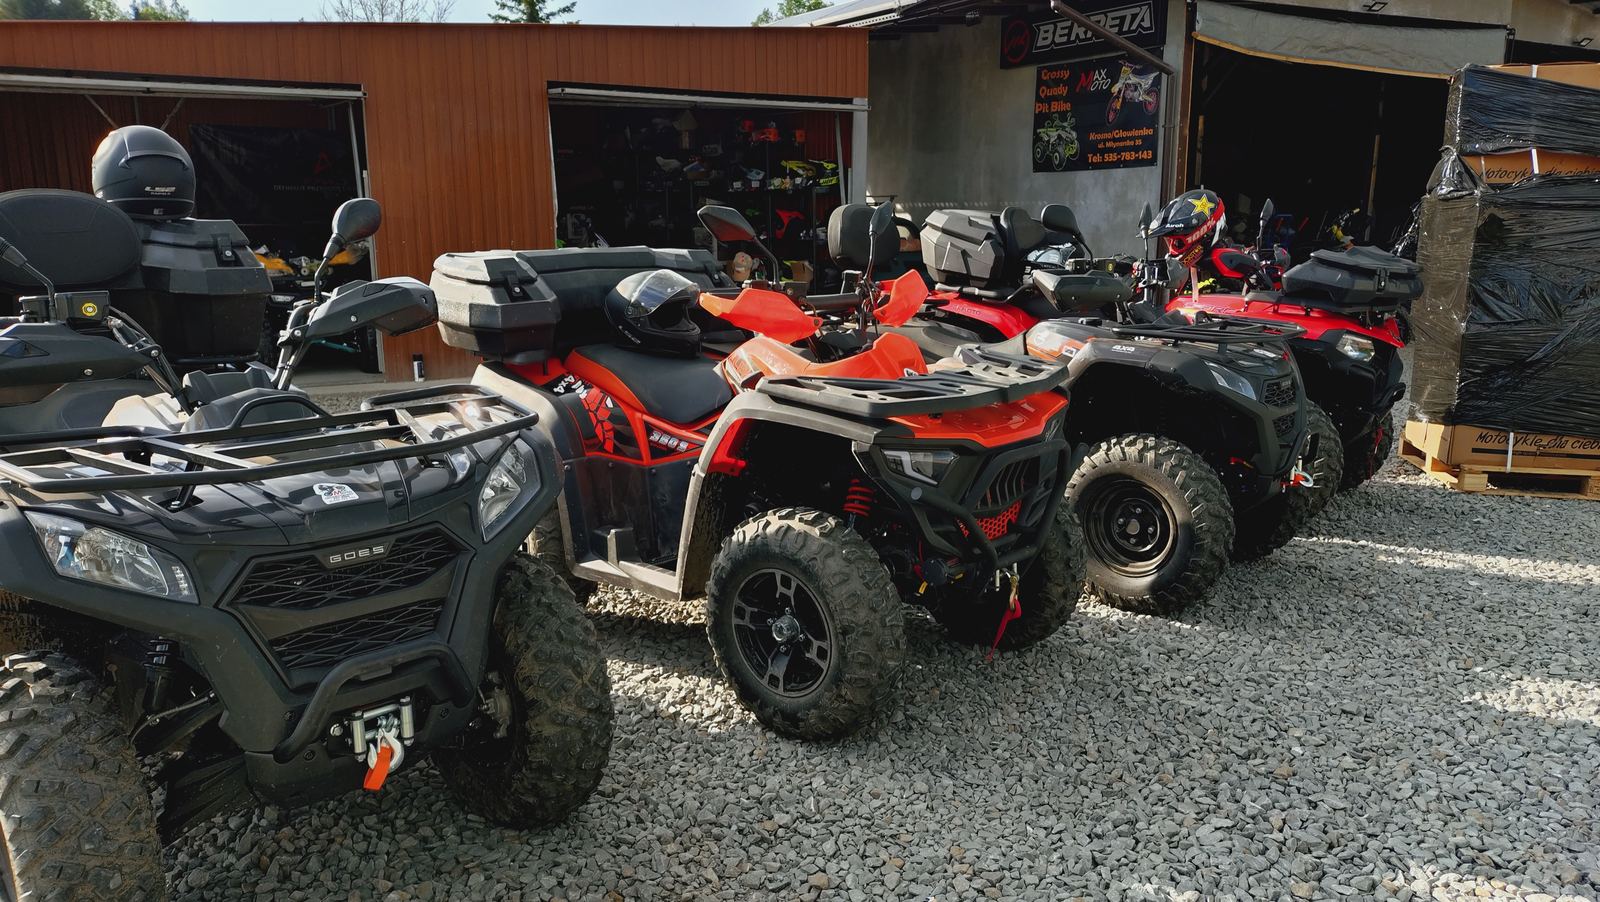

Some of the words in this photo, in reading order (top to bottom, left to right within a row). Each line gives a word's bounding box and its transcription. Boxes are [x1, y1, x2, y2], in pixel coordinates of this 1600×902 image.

[1041, 69, 1070, 80] Crossy
[1040, 84, 1068, 98] Quady
[1035, 101, 1049, 113] Pit
[1051, 100, 1071, 112] Bike
[1104, 150, 1152, 162] 535-783-143
[329, 545, 384, 563] GOES
